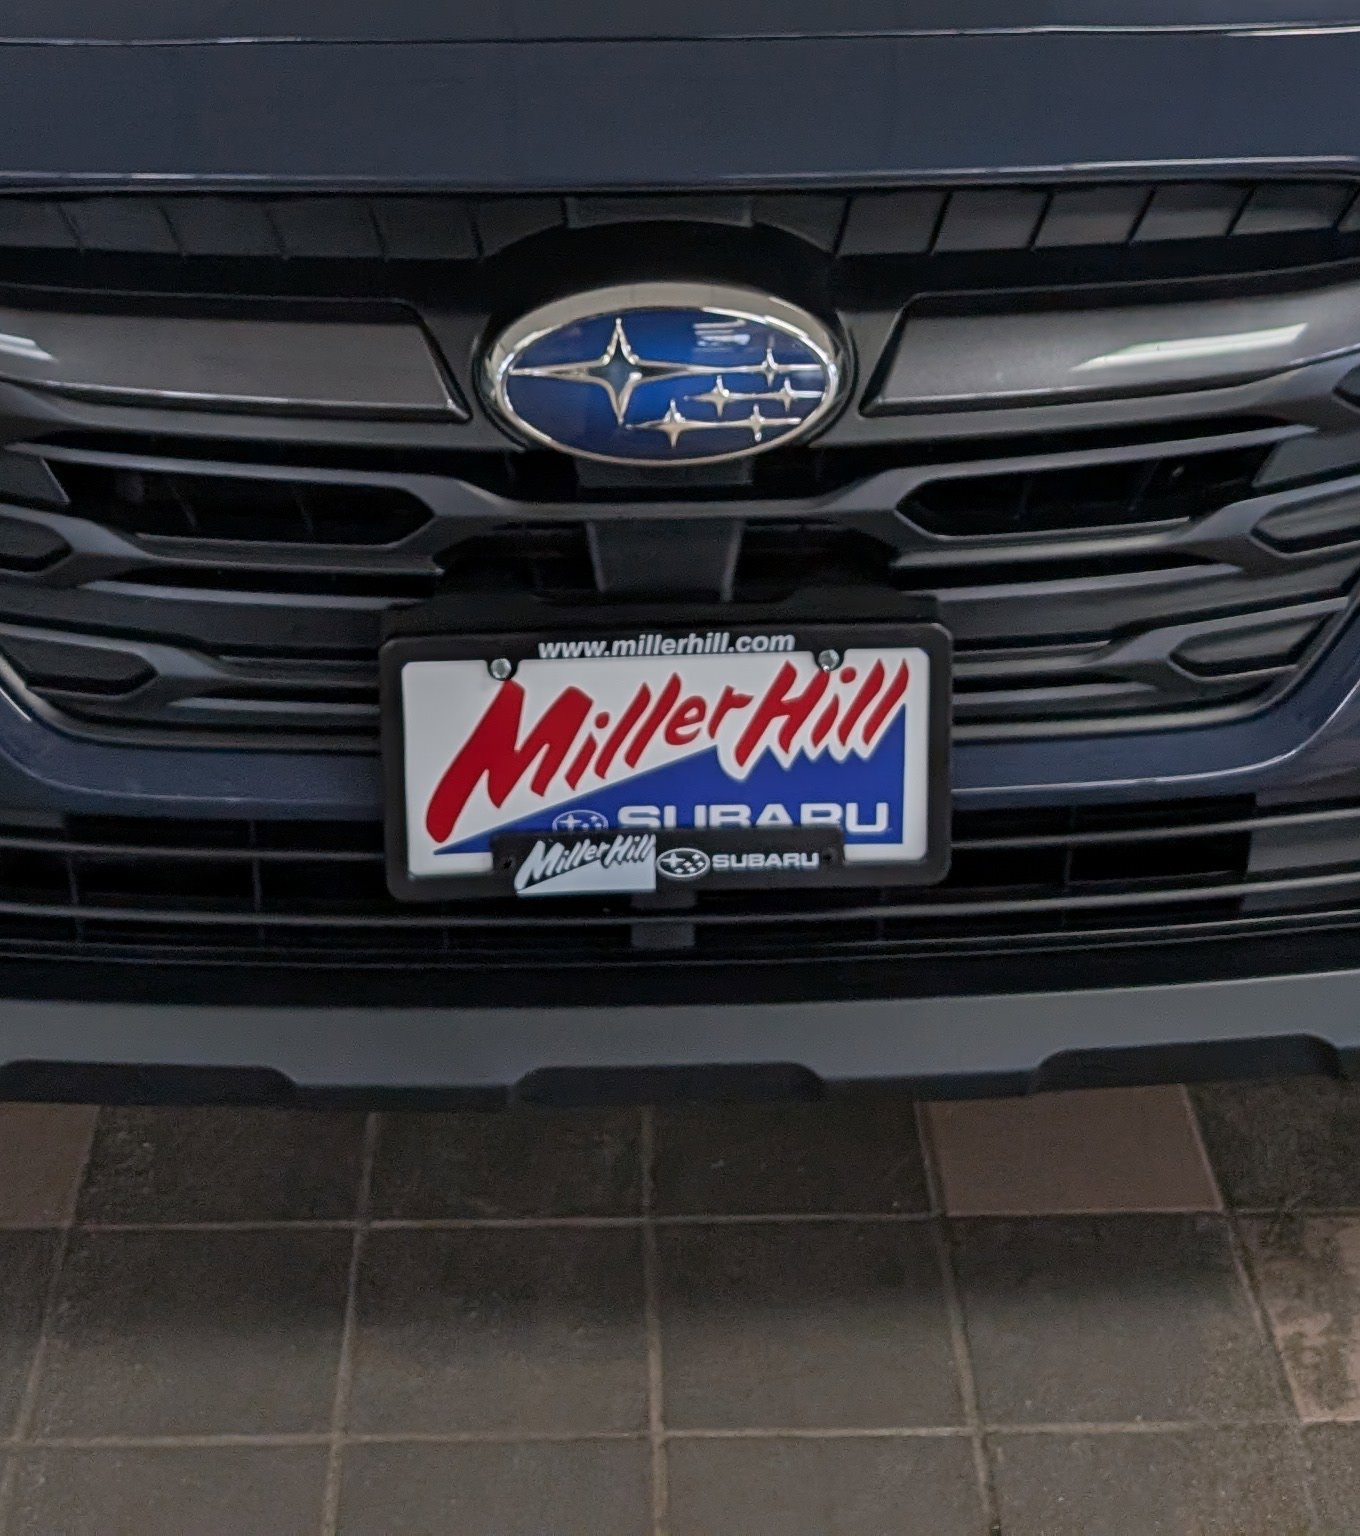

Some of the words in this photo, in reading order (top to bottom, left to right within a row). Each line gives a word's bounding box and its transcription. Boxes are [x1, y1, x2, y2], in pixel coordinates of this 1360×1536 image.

[538, 631, 796, 659] www.millerhill.com
[616, 802, 890, 834] SUBARU
[711, 852, 821, 870] SUBARU
